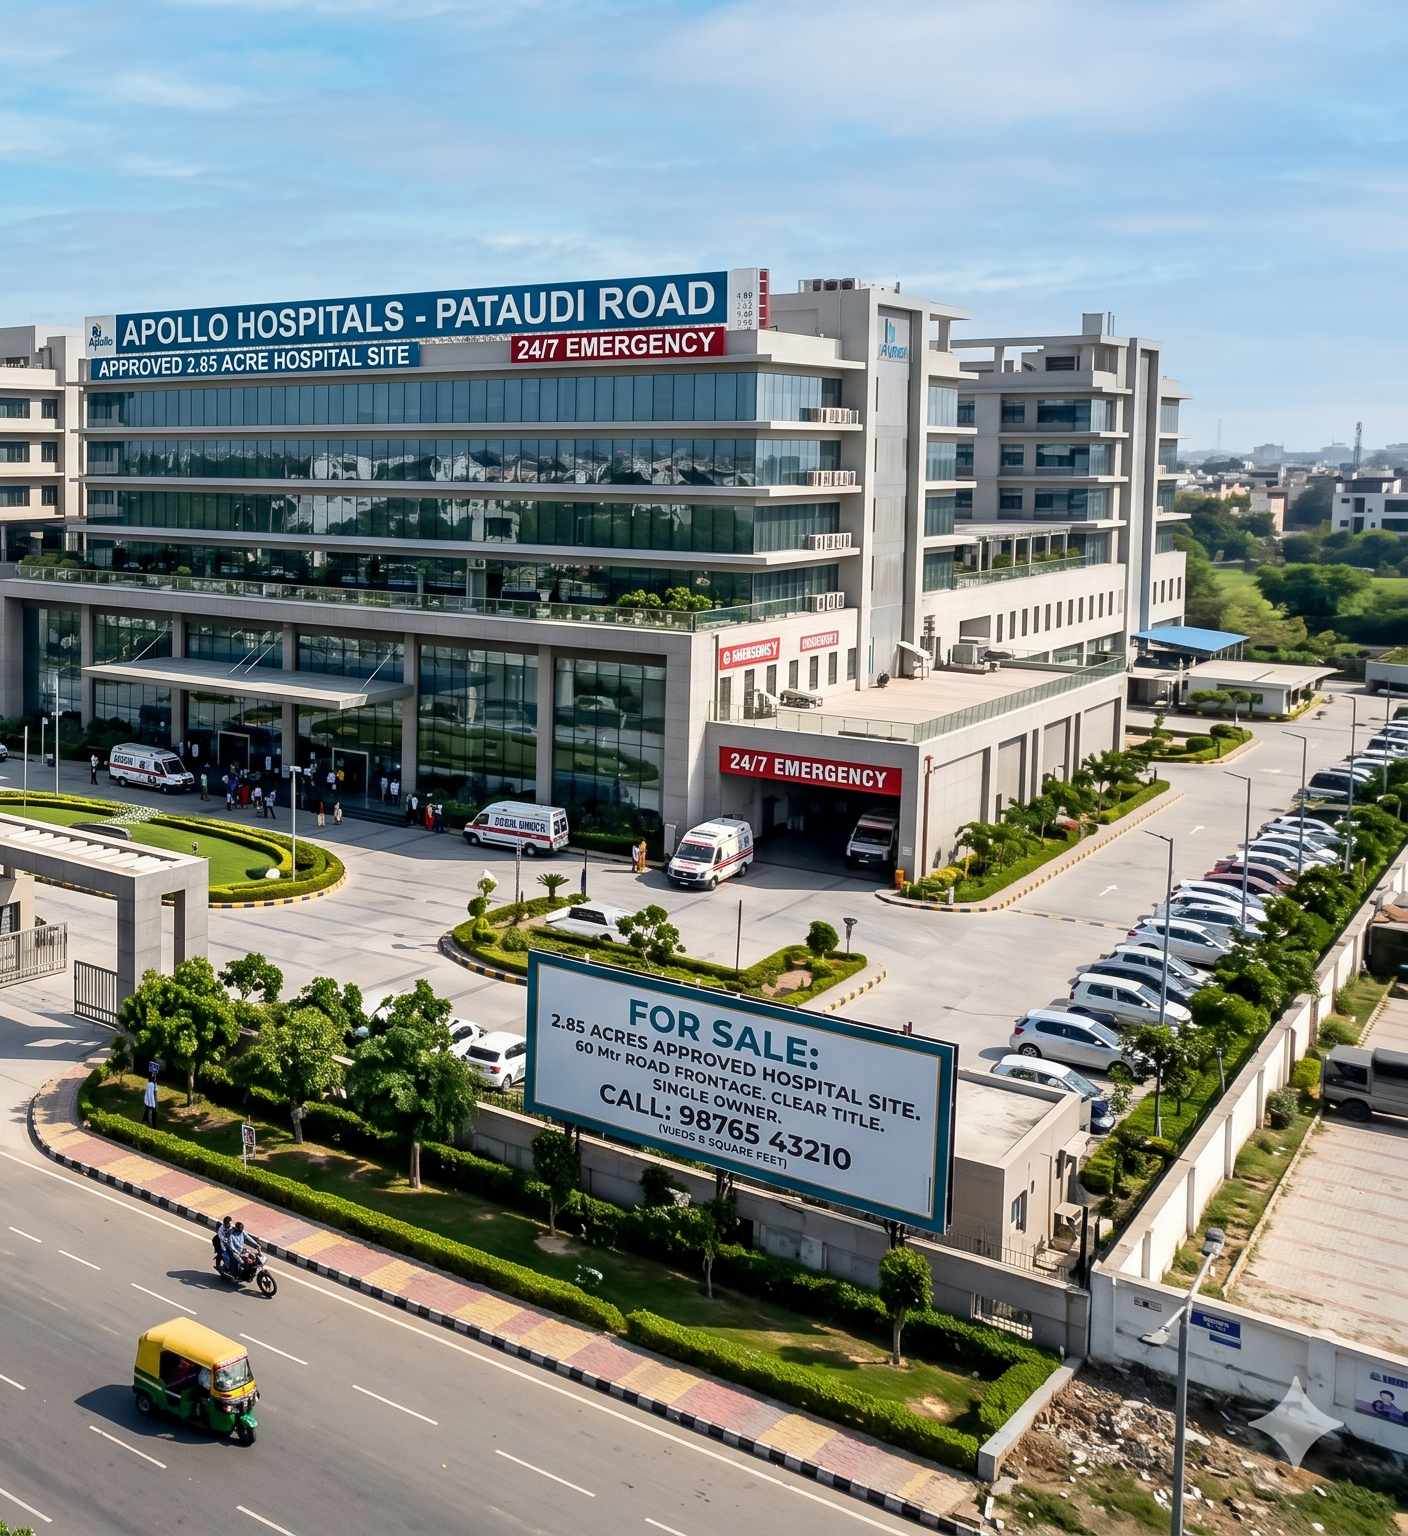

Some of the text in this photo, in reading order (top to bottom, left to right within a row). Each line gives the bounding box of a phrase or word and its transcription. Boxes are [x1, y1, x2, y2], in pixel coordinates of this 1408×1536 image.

[122, 313, 228, 346] APOLLO
[238, 301, 404, 340] HOSPITALS
[437, 289, 584, 329] PATAUDI
[599, 281, 715, 320] ROAD
[99, 345, 409, 377] APPROVED 2.85 ACRE HOSPITAL SITE
[518, 331, 715, 359] 24/7 EMERGENCY
[730, 753, 887, 788] 24/7 EMERGENCY
[630, 999, 819, 1071] FOR SALE:
[552, 1014, 921, 1121] 2.85 ACRES APPROVED HOSPITAL SITE.
[576, 1040, 884, 1132] 60 Mtr ROAD FRONTAGE. CLEAR TITLE.
[600, 1084, 852, 1171] CALL: 98765 43210
[653, 1078, 782, 1124] SINGLE OWNER.
[709, 1138, 753, 1158] SQUARE
[756, 1152, 787, 1169] FEET)
